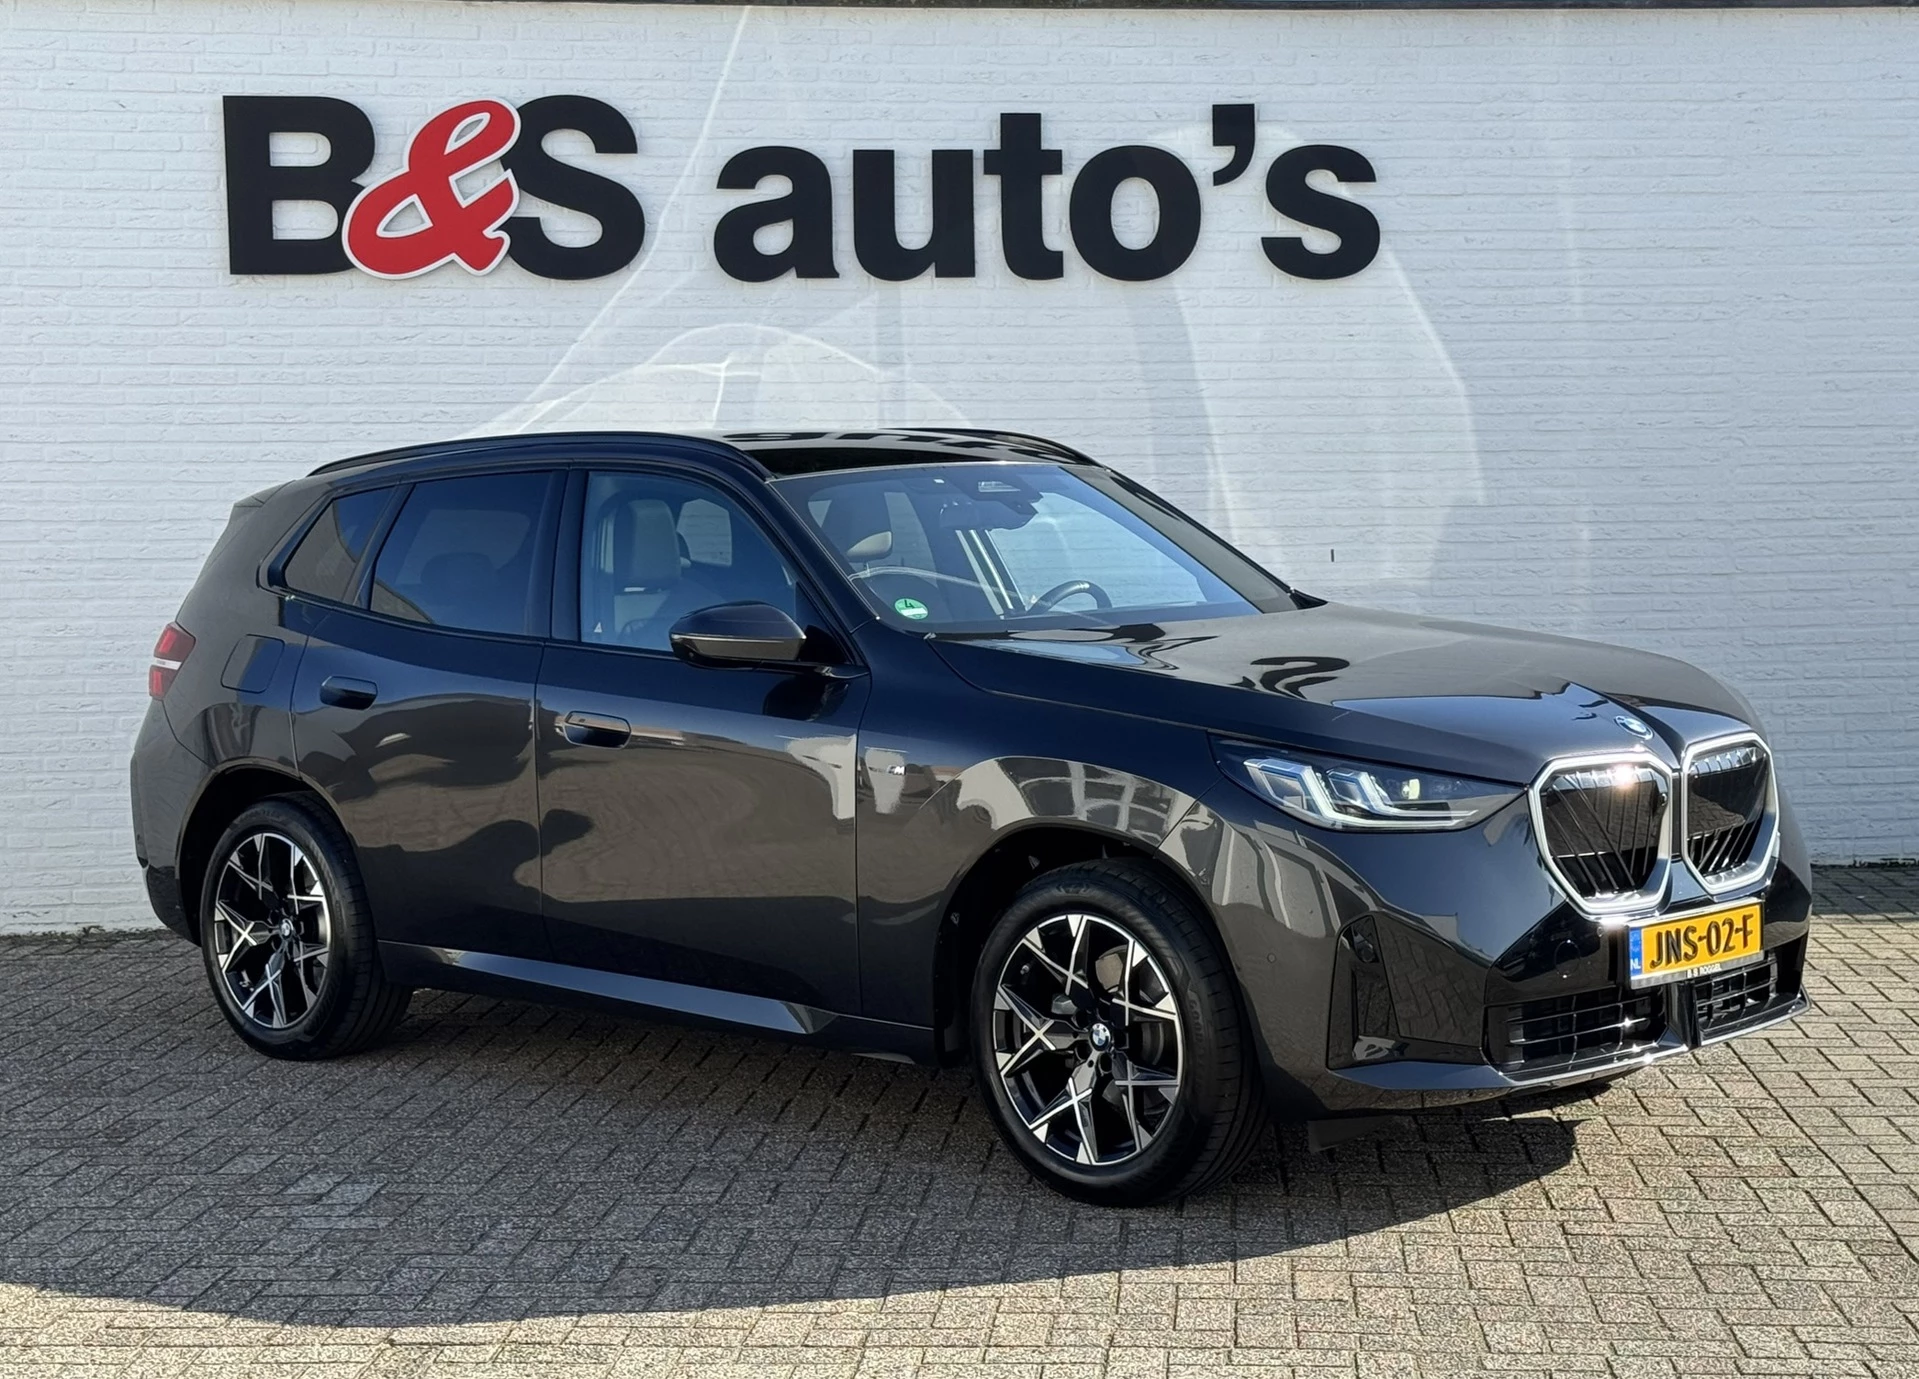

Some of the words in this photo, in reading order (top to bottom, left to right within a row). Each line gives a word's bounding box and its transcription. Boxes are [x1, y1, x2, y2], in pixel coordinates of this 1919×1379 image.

[222, 94, 646, 281] B&S
[712, 103, 1382, 283] auto's
[1630, 958, 1641, 971] NL
[1649, 913, 1754, 969] JNS-02-F
